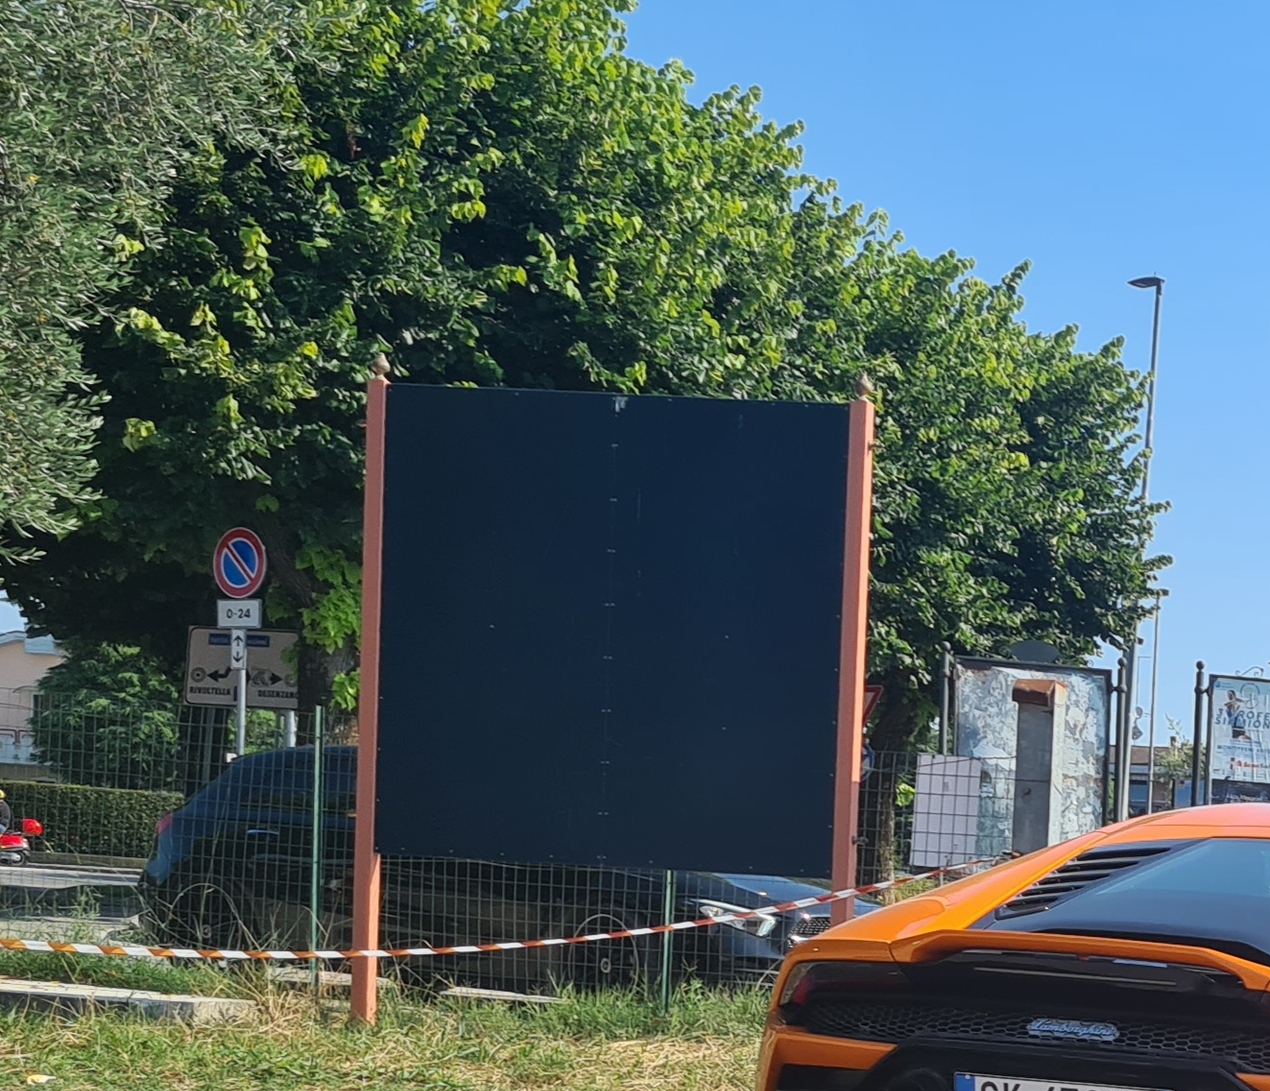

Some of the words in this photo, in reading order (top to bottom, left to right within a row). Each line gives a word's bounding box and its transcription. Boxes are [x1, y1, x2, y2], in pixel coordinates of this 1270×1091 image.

[226, 608, 251, 619] 0-24
[190, 686, 231, 696] RIVOLTELLA
[1028, 1019, 1117, 1037] Lamborghini
